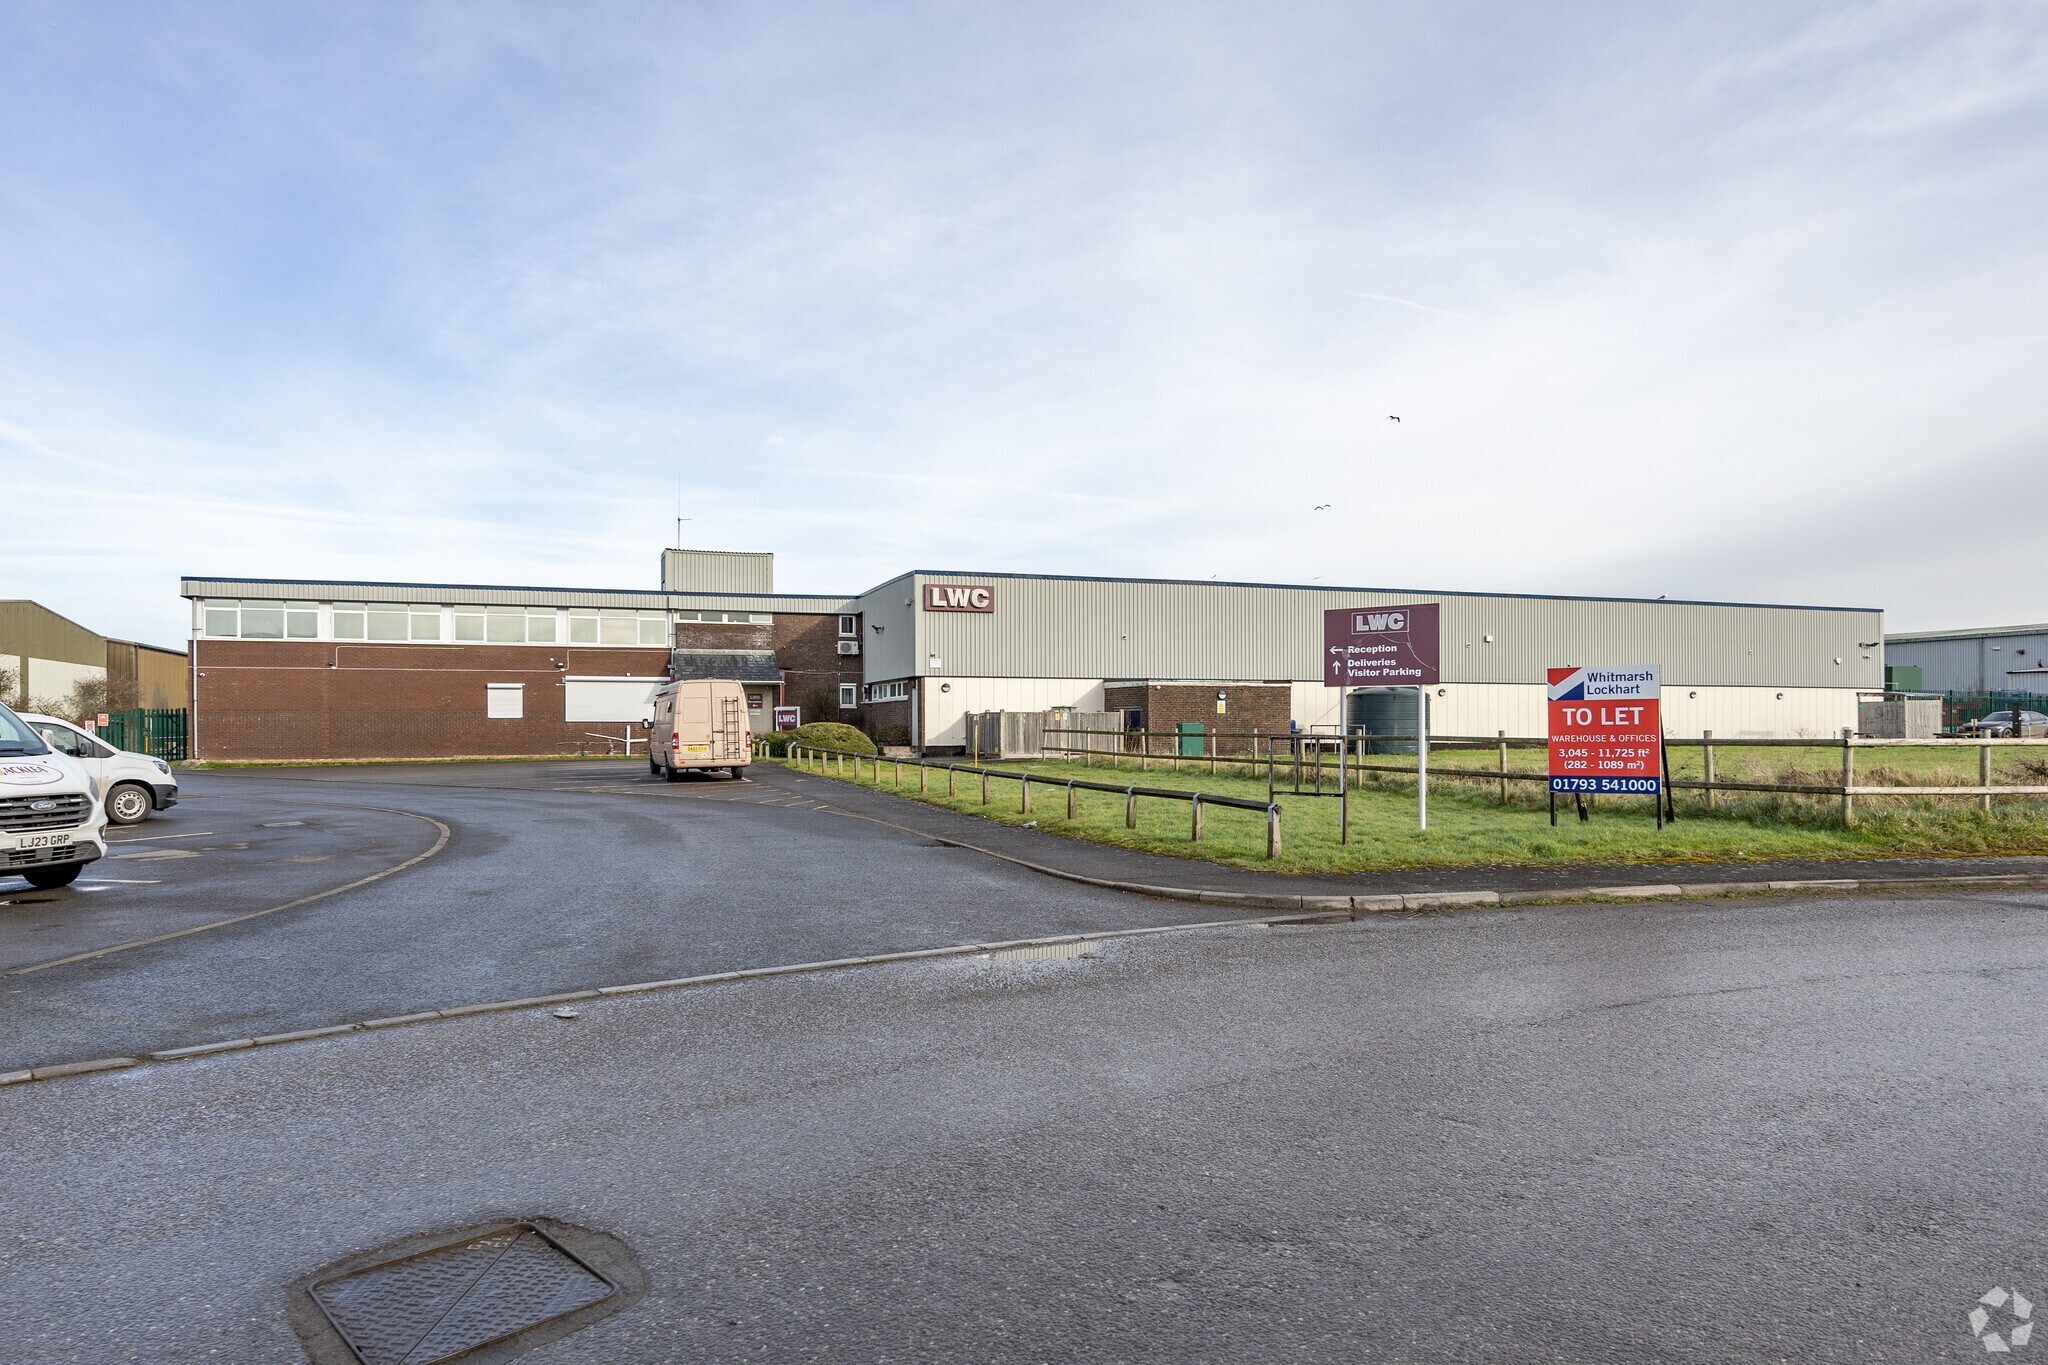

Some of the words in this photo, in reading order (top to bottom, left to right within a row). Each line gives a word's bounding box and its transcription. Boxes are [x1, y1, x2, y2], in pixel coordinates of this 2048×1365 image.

[930, 587, 989, 608] LWC
[1356, 613, 1404, 631] LWC
[1348, 644, 1398, 655] Reception
[1347, 658, 1397, 668] Deliveries
[1347, 668, 1381, 678] Visitor
[1383, 667, 1422, 678] Parking
[1587, 671, 1653, 683] Whitmarsh
[1587, 684, 1641, 695] Lockhart
[778, 714, 796, 723] LWC
[1562, 707, 1593, 726] TO
[1601, 706, 1644, 726] LET
[1551, 734, 1607, 743] WAREHOUSE
[1609, 734, 1616, 743] &
[1618, 734, 1657, 743] OFFICES
[1558, 748, 1588, 758] 3,045
[1598, 748, 1635, 758] 11,725
[1564, 760, 1588, 770] (282
[1598, 760, 1624, 769] 1089
[2, 766, 48, 776] ACKLEA
[1553, 778, 1597, 790] 01793
[1601, 779, 1656, 791] 541000
[37, 801, 53, 809] Ford
[20, 836, 48, 848] LJ23
[50, 834, 70, 846] GRP
